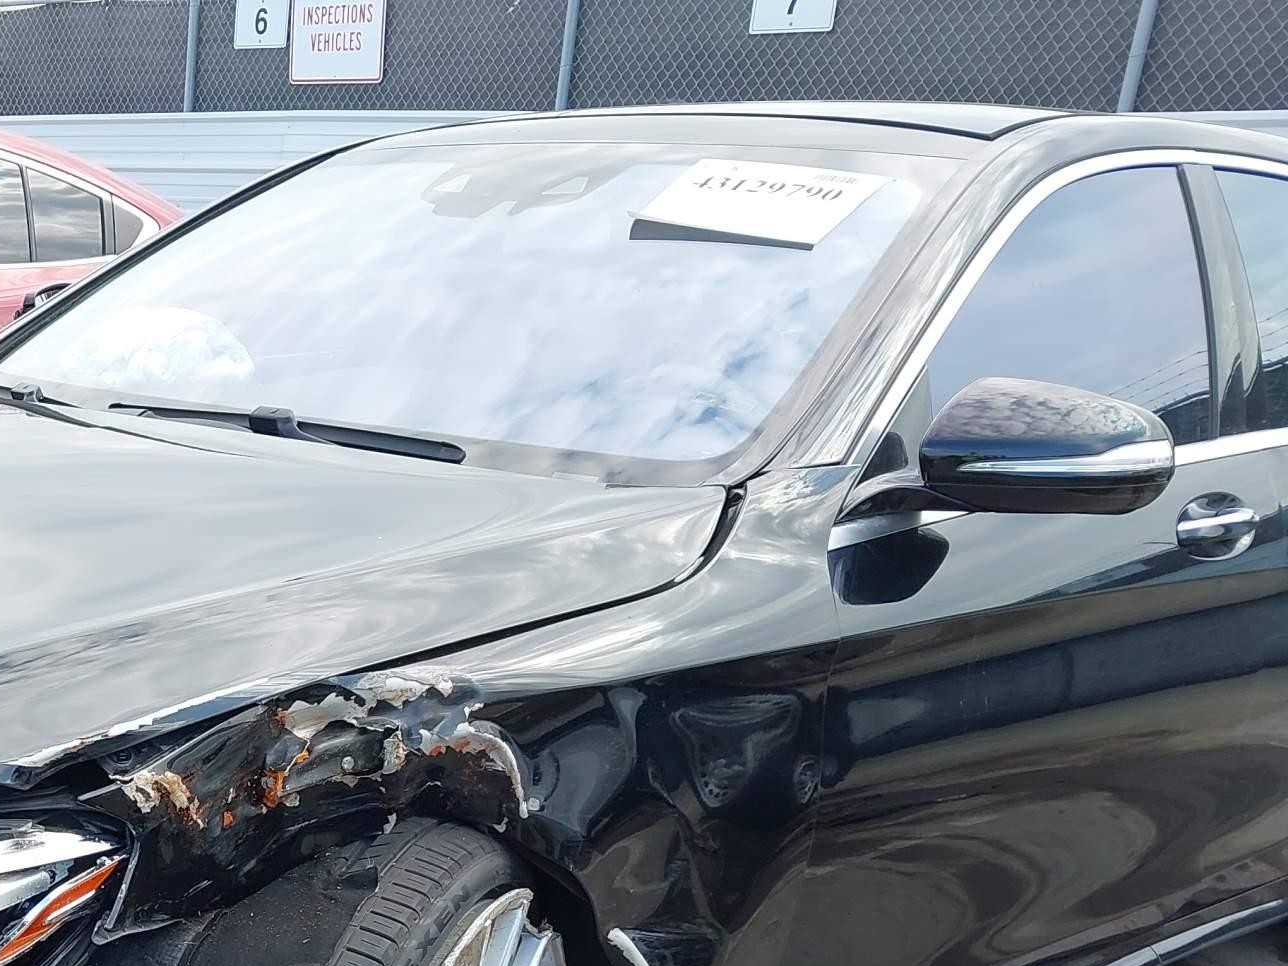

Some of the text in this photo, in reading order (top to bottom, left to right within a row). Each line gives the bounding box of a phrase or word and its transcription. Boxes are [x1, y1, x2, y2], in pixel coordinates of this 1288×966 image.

[255, 8, 268, 35] 6
[303, 4, 374, 26] INSPECTIONS
[311, 32, 362, 52] VEHICLES
[692, 175, 844, 201] 43129790
